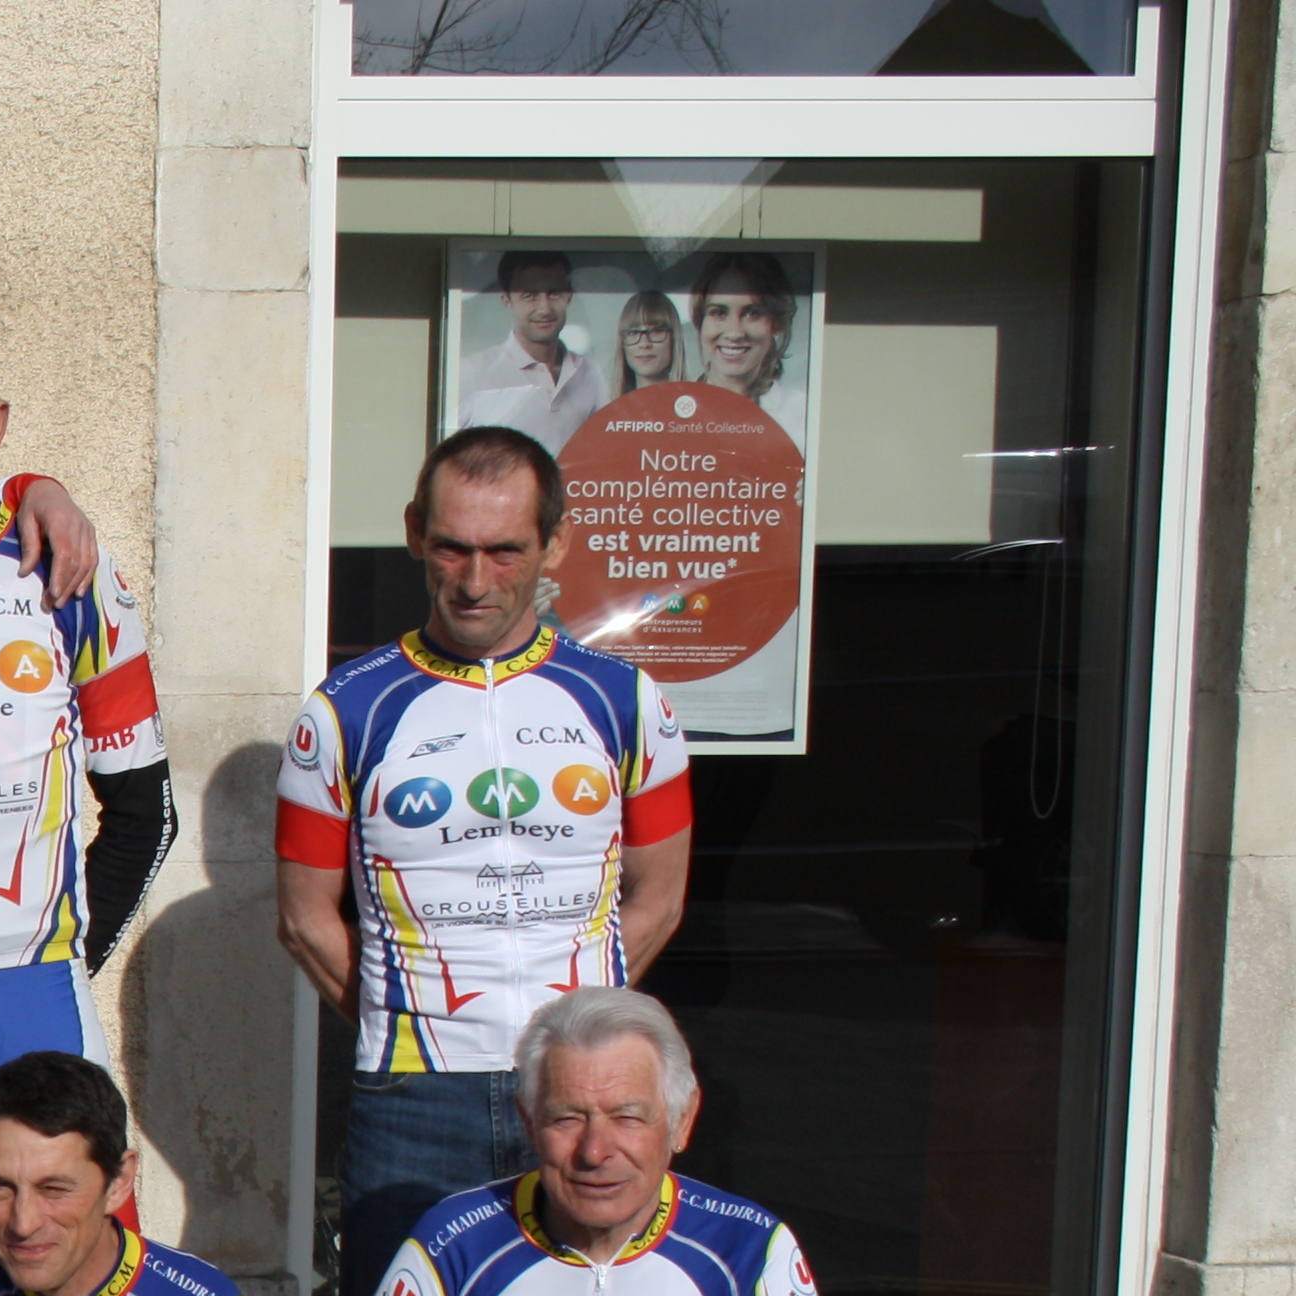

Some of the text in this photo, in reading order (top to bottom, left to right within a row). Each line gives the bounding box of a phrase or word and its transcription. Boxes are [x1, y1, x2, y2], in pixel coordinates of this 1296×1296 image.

[605, 421, 764, 434] AFFIPRO Santé Collective
[641, 450, 716, 471] Notre
[566, 476, 787, 502] complémentaire
[570, 503, 780, 526] santé collective
[588, 530, 760, 552] est vraiment
[608, 556, 667, 579] bien
[505, 635, 552, 672] C.C.M
[516, 728, 587, 745] C.C.M
[439, 821, 575, 844] Lembeye
[422, 892, 596, 916] CROUSEILLES
